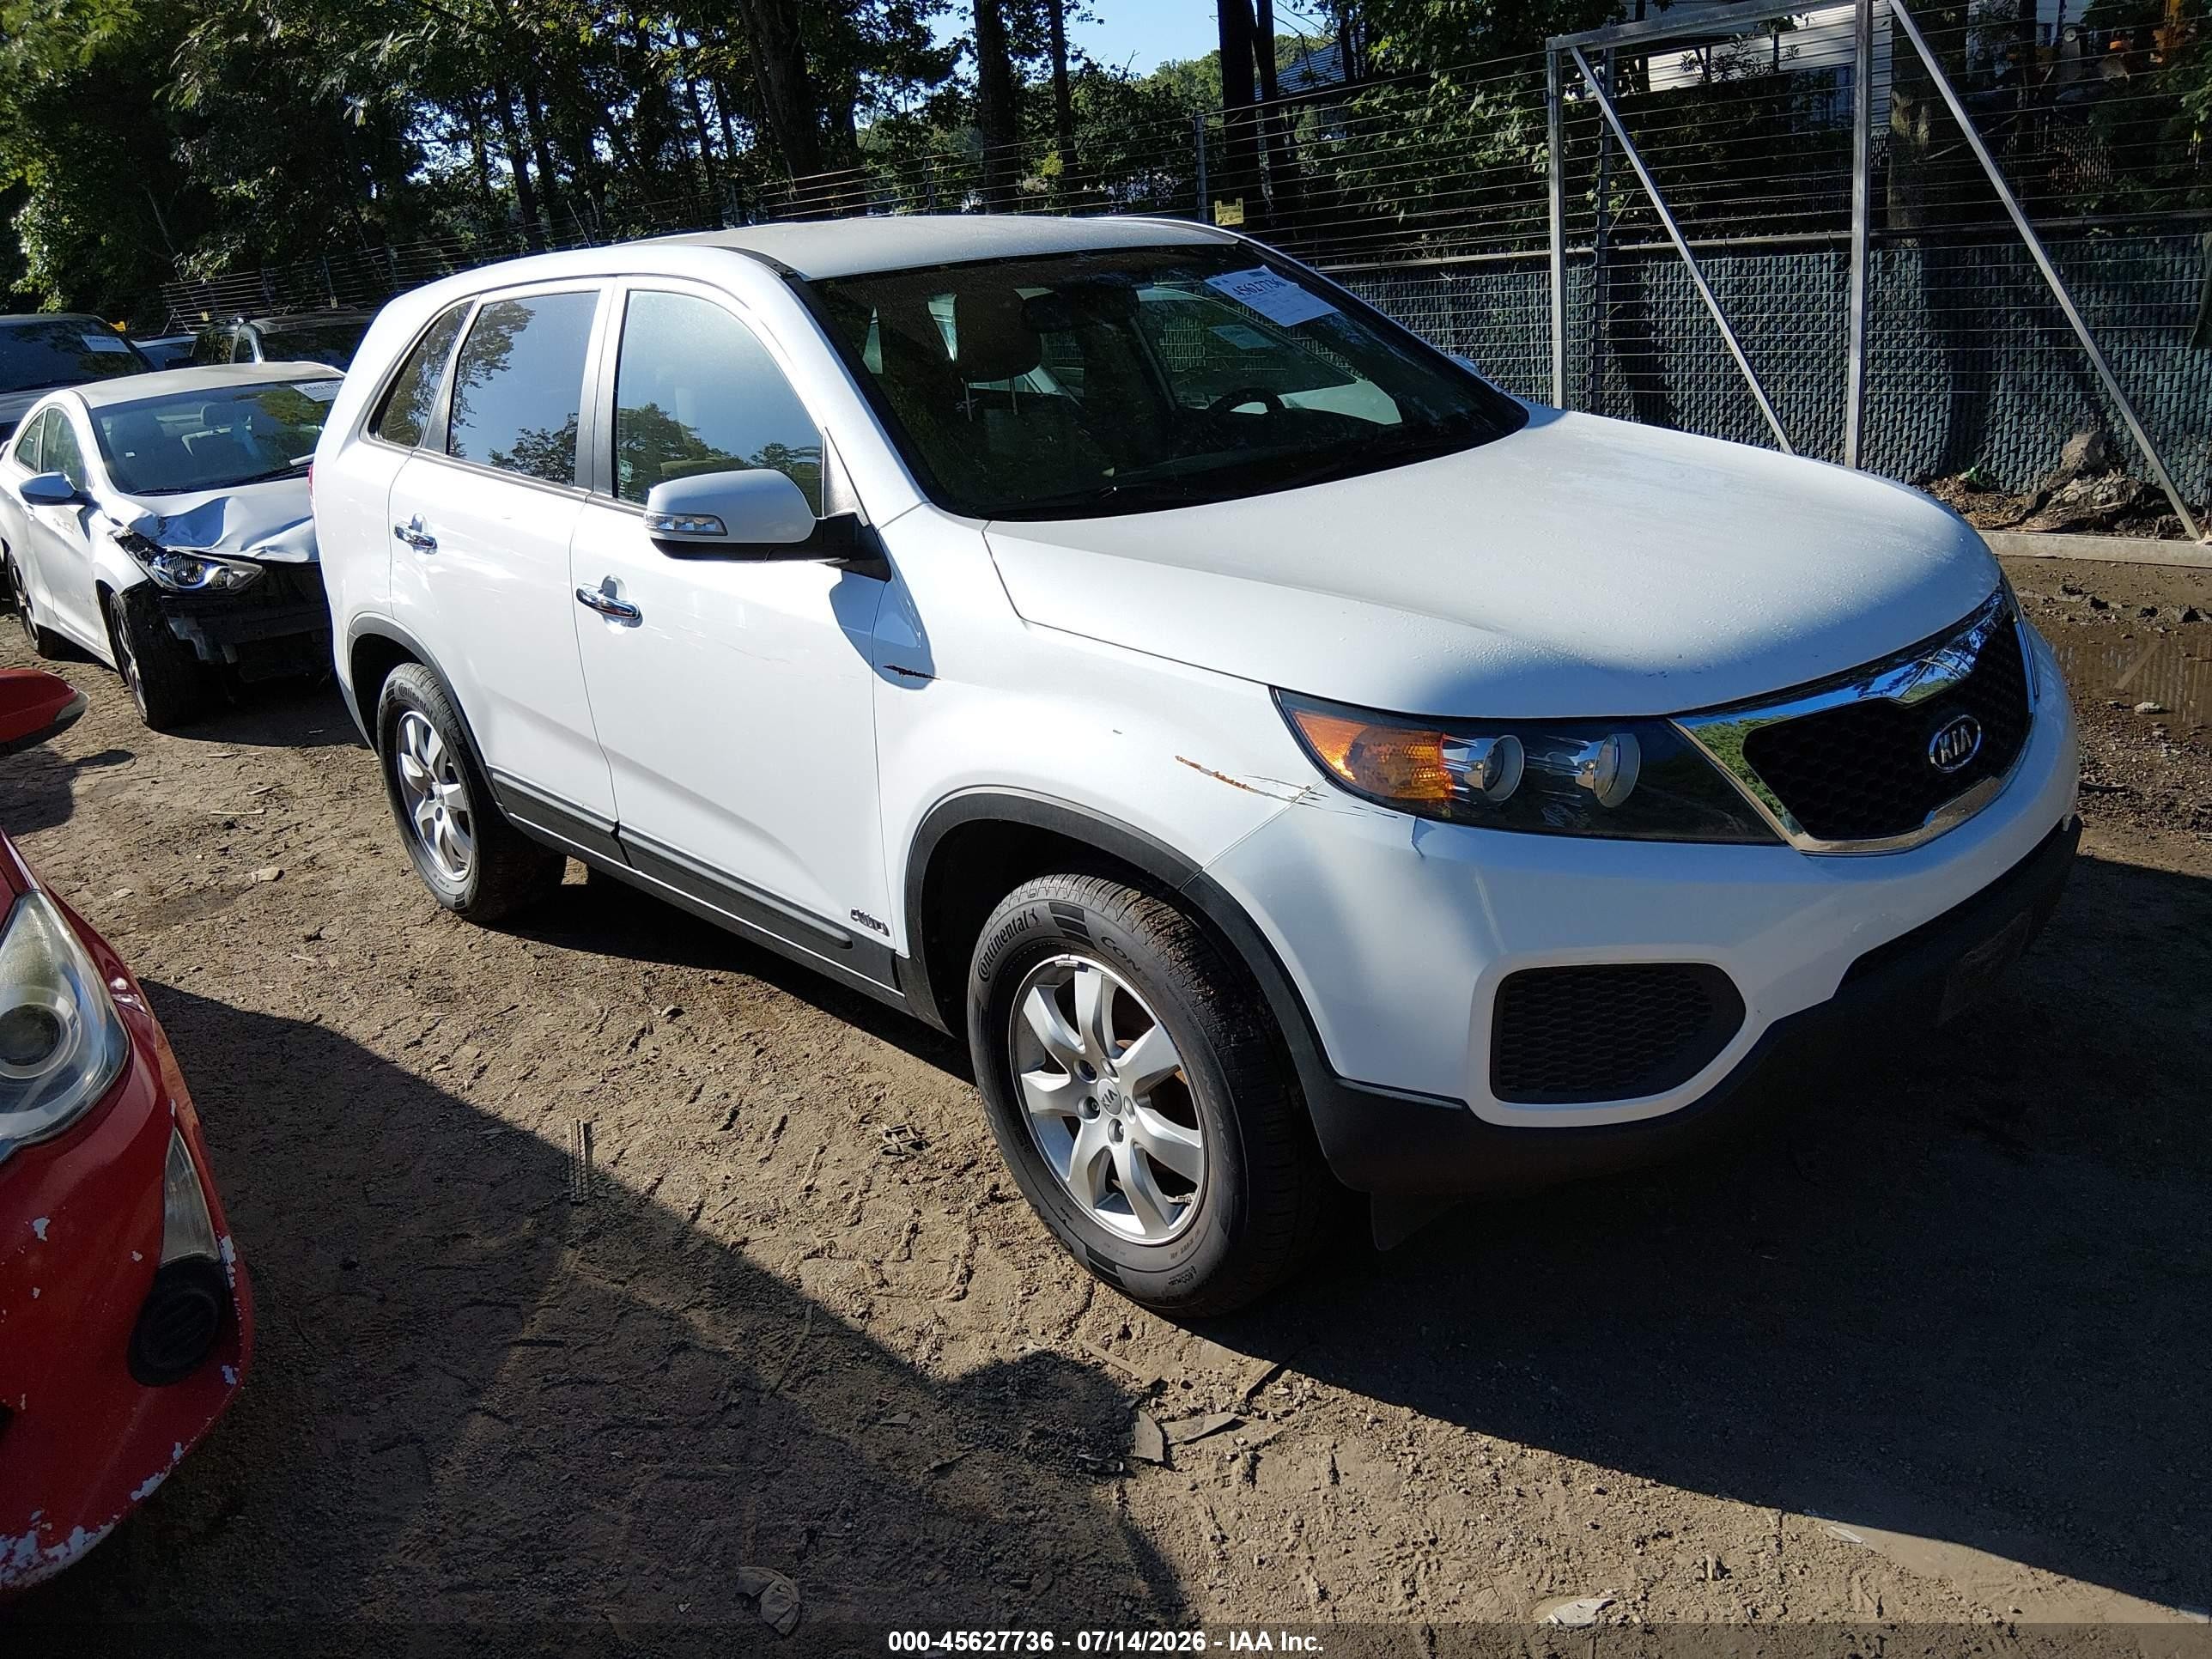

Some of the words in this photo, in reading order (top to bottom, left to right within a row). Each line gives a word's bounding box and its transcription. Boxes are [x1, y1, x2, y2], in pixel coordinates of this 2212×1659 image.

[1231, 277, 1286, 298] 45627736
[398, 682, 434, 719] Continental
[1938, 724, 1973, 764] KIA
[977, 909, 1031, 983] Continental
[1100, 1088, 1118, 1108] KIA
